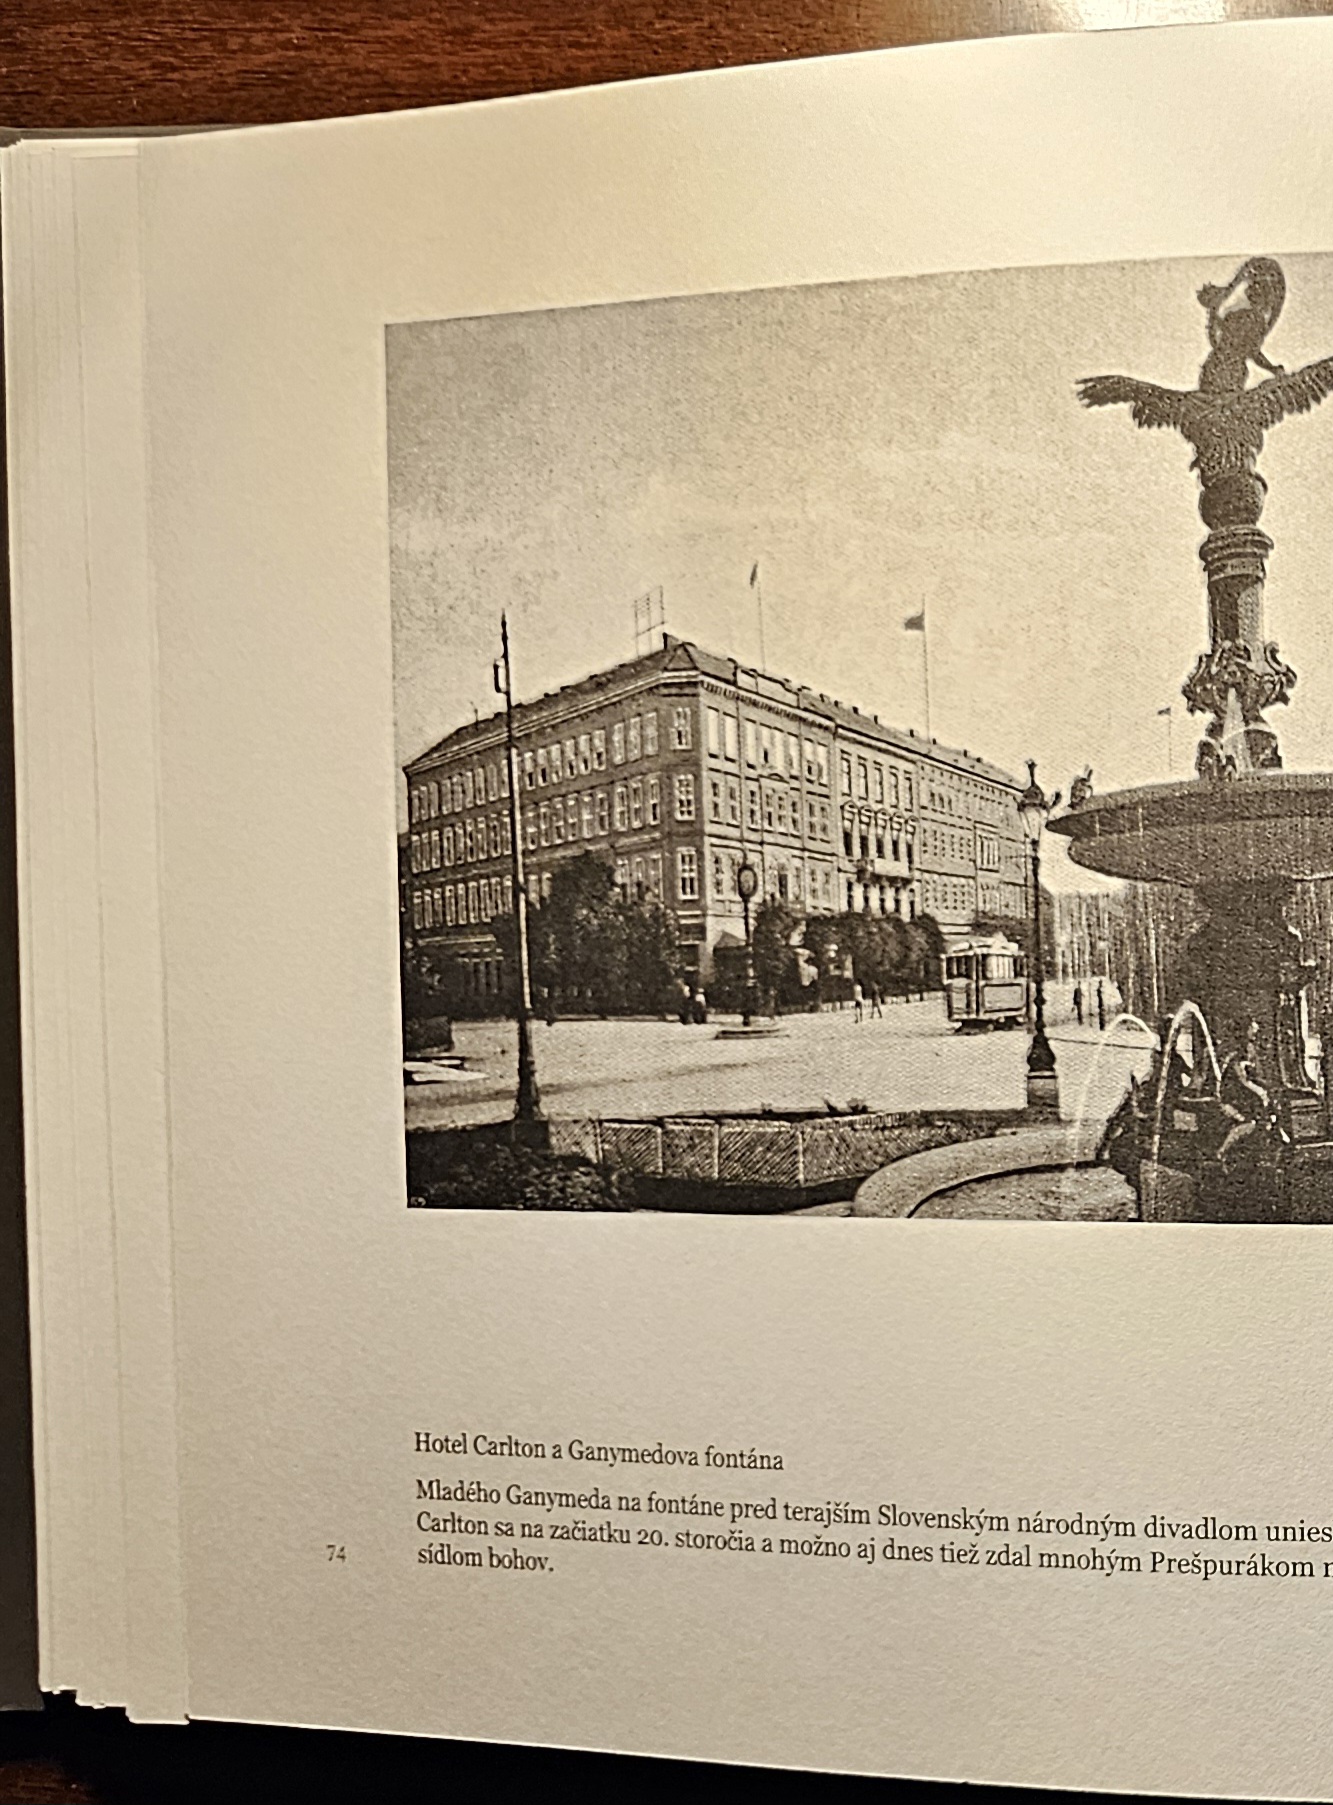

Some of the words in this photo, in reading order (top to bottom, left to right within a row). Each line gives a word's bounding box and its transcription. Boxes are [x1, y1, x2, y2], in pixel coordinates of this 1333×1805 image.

[414, 1431, 468, 1455] Hotel
[472, 1434, 547, 1459] Carlton
[551, 1443, 563, 1460] a
[567, 1438, 700, 1468] Ganymedova
[704, 1444, 785, 1471] fontána
[415, 1478, 501, 1505] Mladého
[505, 1483, 612, 1513] Ganymeda
[617, 1495, 642, 1513] na
[647, 1490, 725, 1518] fontáne
[729, 1496, 778, 1524] pred
[782, 1500, 871, 1529] terajším
[877, 1503, 1010, 1537] Slovenským
[1017, 1510, 1137, 1542] národným
[1143, 1514, 1259, 1542] divadlom
[326, 1544, 346, 1563] 74
[416, 1510, 489, 1536] Carlton
[493, 1520, 515, 1537] sa
[520, 1522, 545, 1539] na
[549, 1519, 632, 1545] začiatku
[636, 1528, 670, 1547] 20.
[674, 1529, 756, 1553] storočia
[761, 1537, 774, 1553] a
[779, 1534, 851, 1558] možno
[857, 1536, 876, 1565] aj
[882, 1537, 934, 1563] dnes
[938, 1541, 980, 1565] tiež
[985, 1542, 1032, 1568] zdal
[1038, 1546, 1143, 1577] mnohým
[1149, 1551, 1316, 1581] Prešpurákom
[417, 1542, 484, 1568] sídlom
[487, 1545, 554, 1573] bohov.
